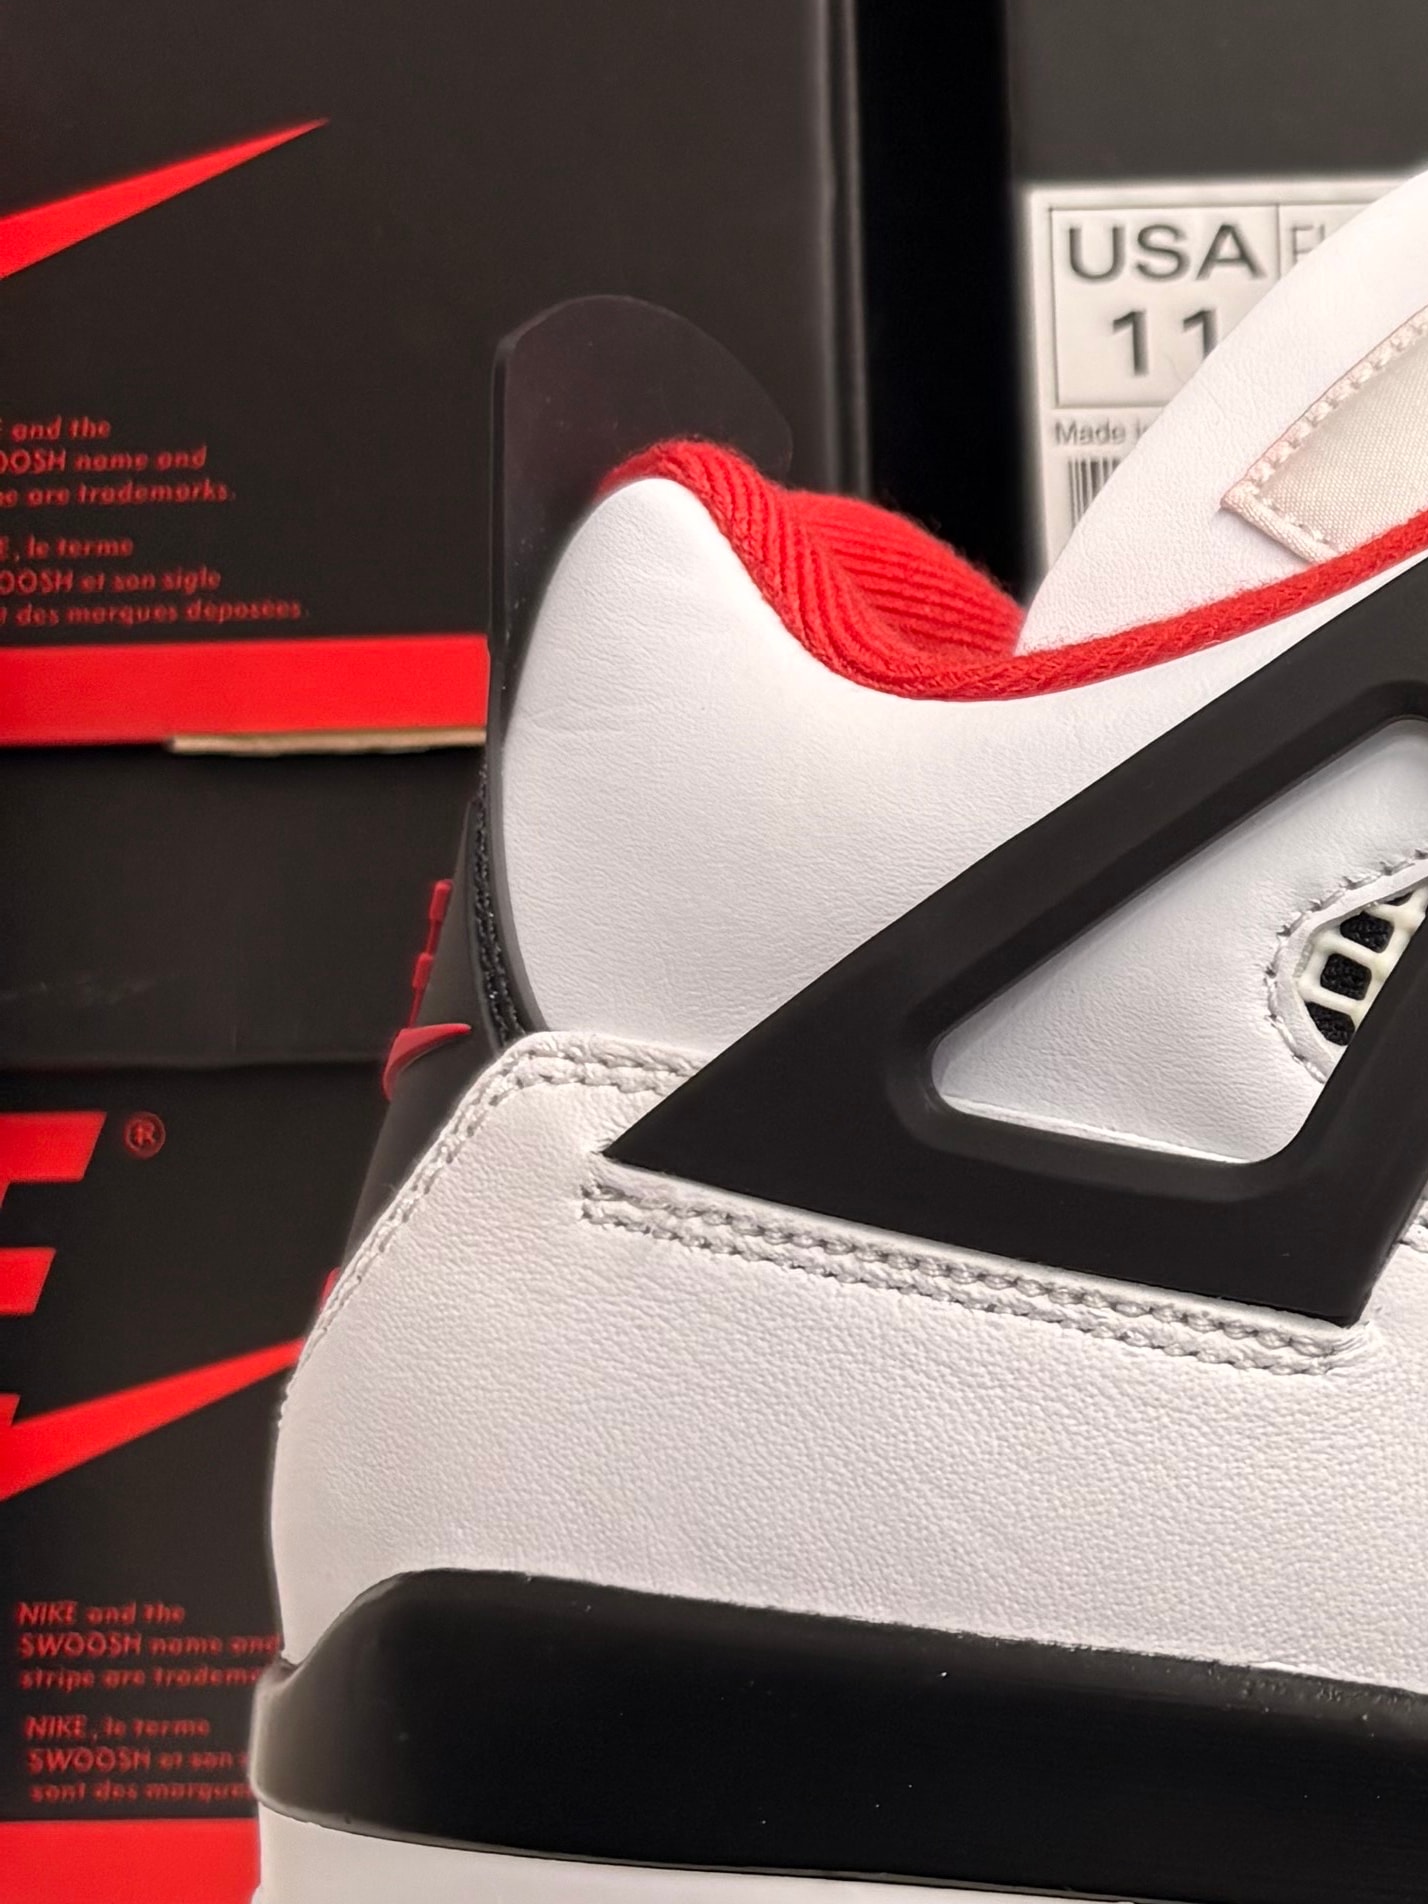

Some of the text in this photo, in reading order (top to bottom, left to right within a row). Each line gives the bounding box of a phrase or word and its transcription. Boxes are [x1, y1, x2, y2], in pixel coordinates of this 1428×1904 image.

[1066, 222, 1269, 283] USA
[11, 415, 62, 442] and
[69, 416, 111, 439] the
[1053, 420, 1126, 445] Made
[74, 453, 149, 471] name
[155, 445, 208, 471] and
[25, 489, 70, 507] are
[56, 537, 134, 557] terme
[111, 573, 156, 591] son
[66, 606, 178, 627] marques
[16, 1600, 186, 1626] NIKE and the
[19, 1632, 143, 1659] SWOOSH
[150, 1636, 223, 1655] name
[20, 1668, 95, 1693] stripe
[102, 1670, 146, 1688] are
[133, 1718, 210, 1737] terme
[27, 1747, 150, 1774] SWOOSH
